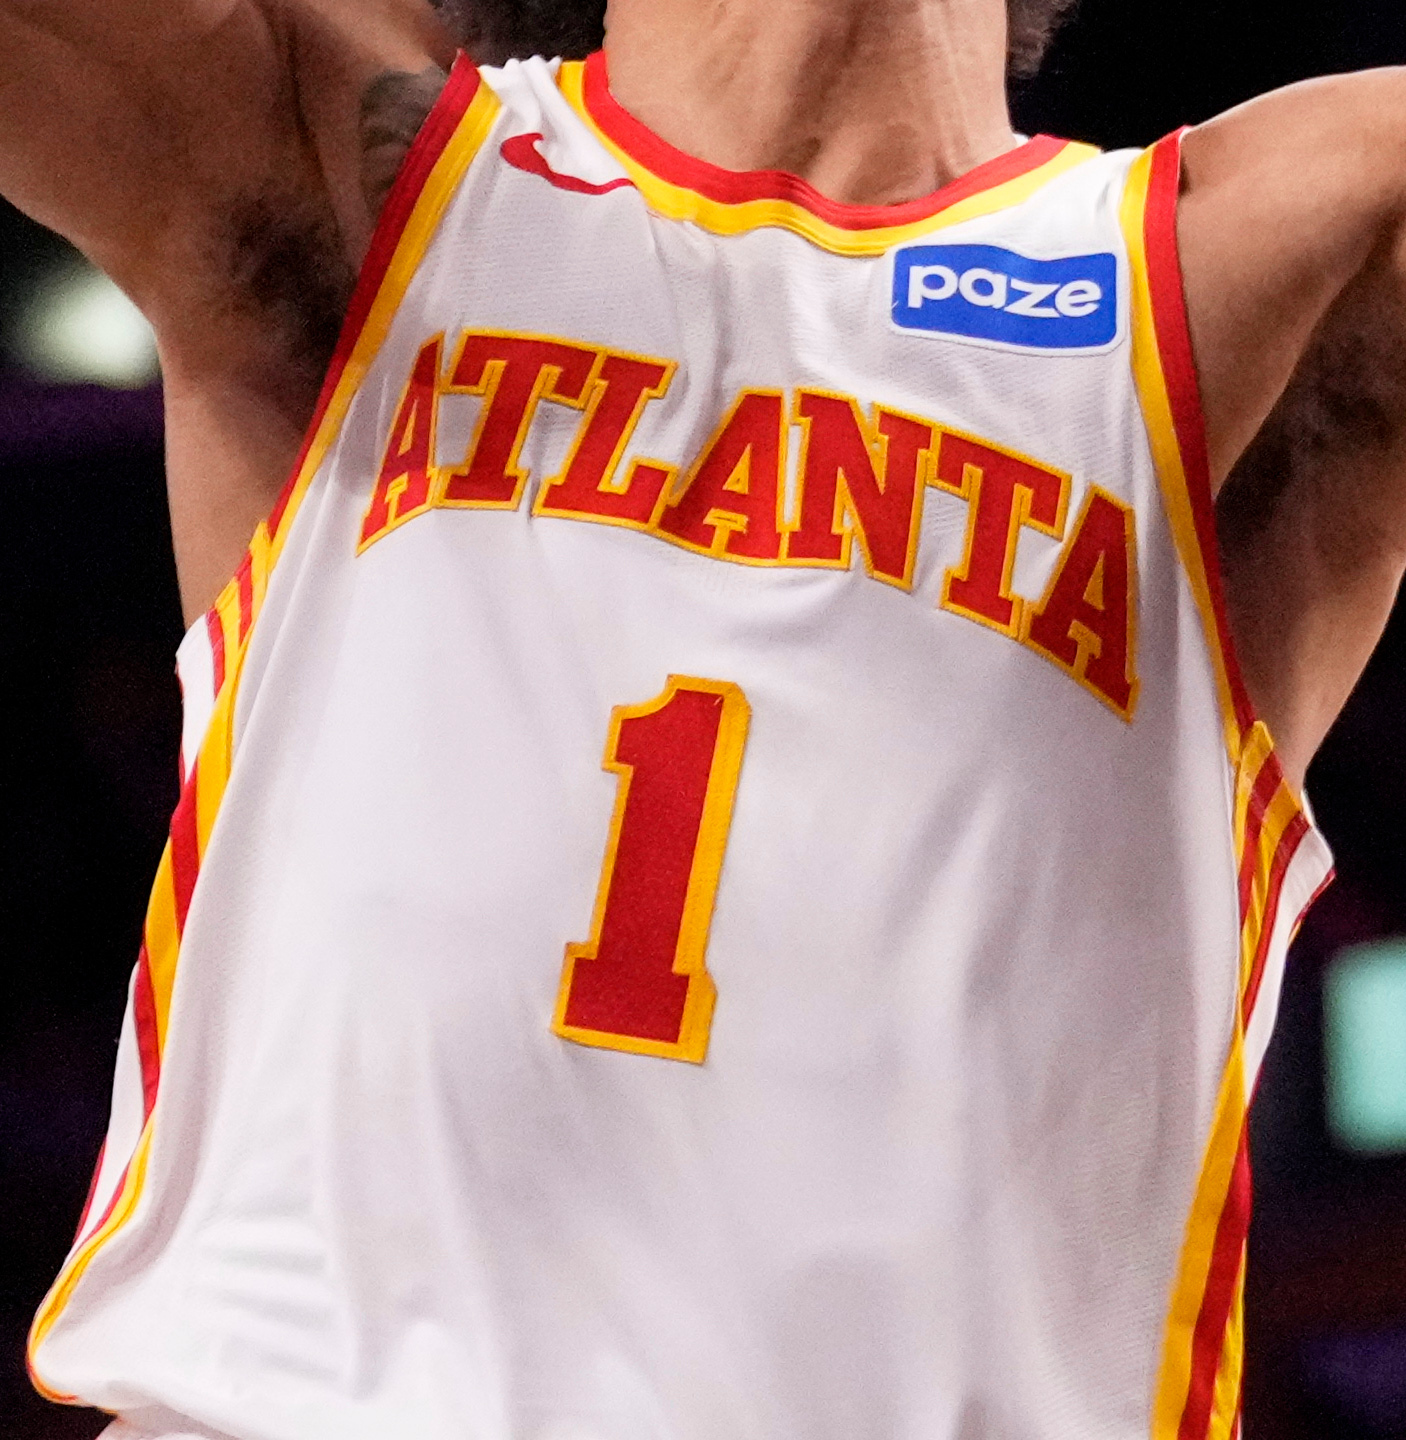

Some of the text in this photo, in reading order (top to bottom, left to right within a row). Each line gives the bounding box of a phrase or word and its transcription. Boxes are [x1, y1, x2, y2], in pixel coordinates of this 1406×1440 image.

[908, 263, 1101, 318] paze
[355, 327, 1140, 724] ATLANTA
[550, 672, 753, 1066] 1
